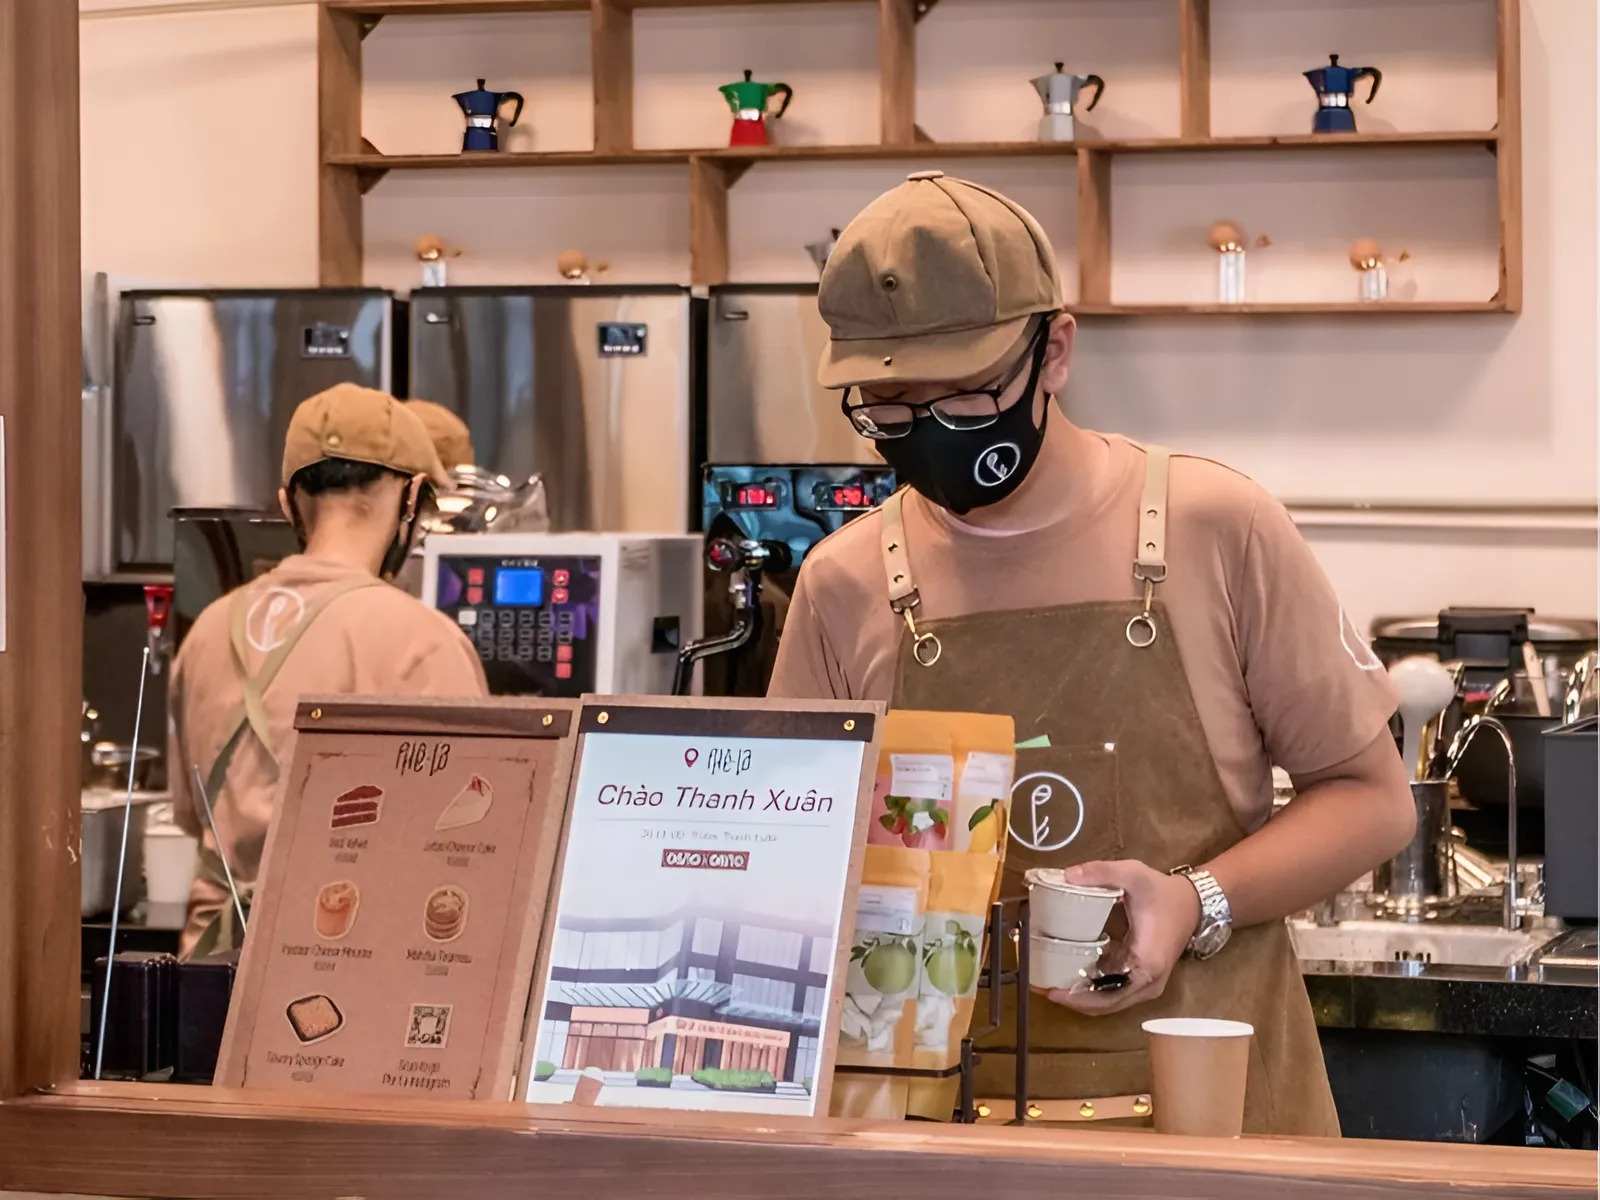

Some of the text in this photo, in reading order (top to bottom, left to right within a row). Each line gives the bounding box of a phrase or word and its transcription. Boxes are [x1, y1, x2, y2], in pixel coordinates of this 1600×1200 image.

[597, 784, 833, 813] Chào Thanh Xuân
